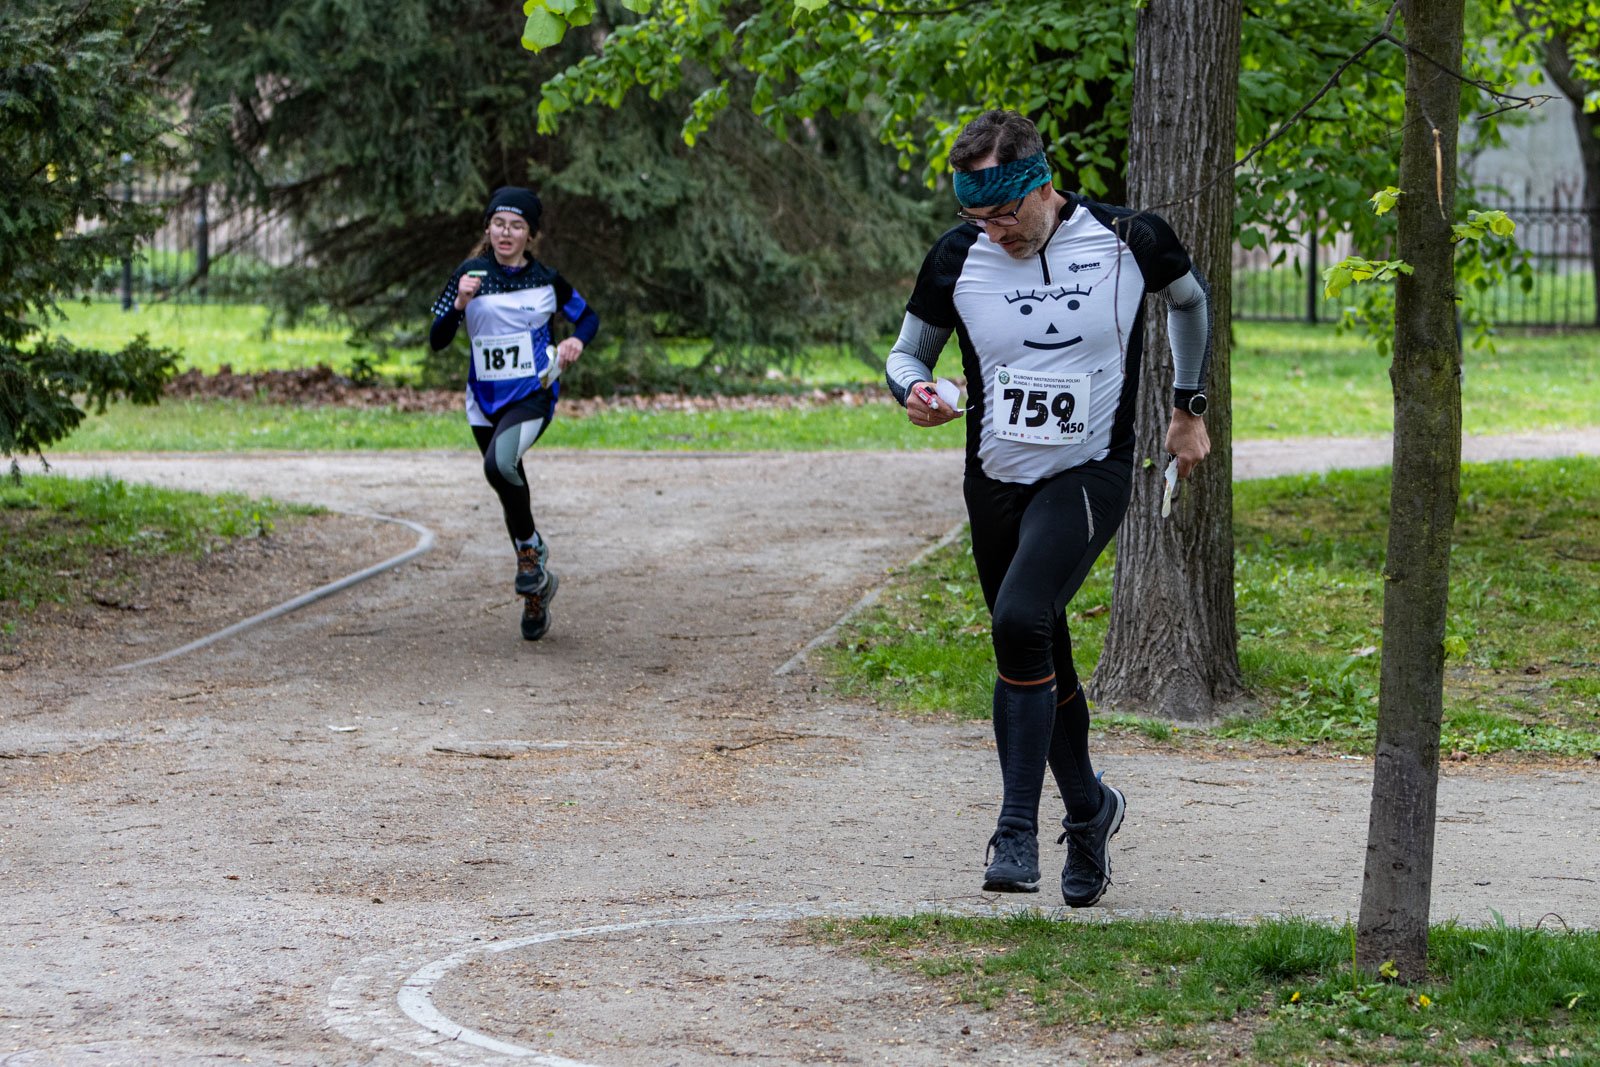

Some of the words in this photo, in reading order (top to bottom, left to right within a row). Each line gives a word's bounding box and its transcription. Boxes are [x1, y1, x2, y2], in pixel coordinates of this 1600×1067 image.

[483, 345, 519, 370] 187
[1003, 388, 1075, 427] 759
[1060, 422, 1084, 434] M50
